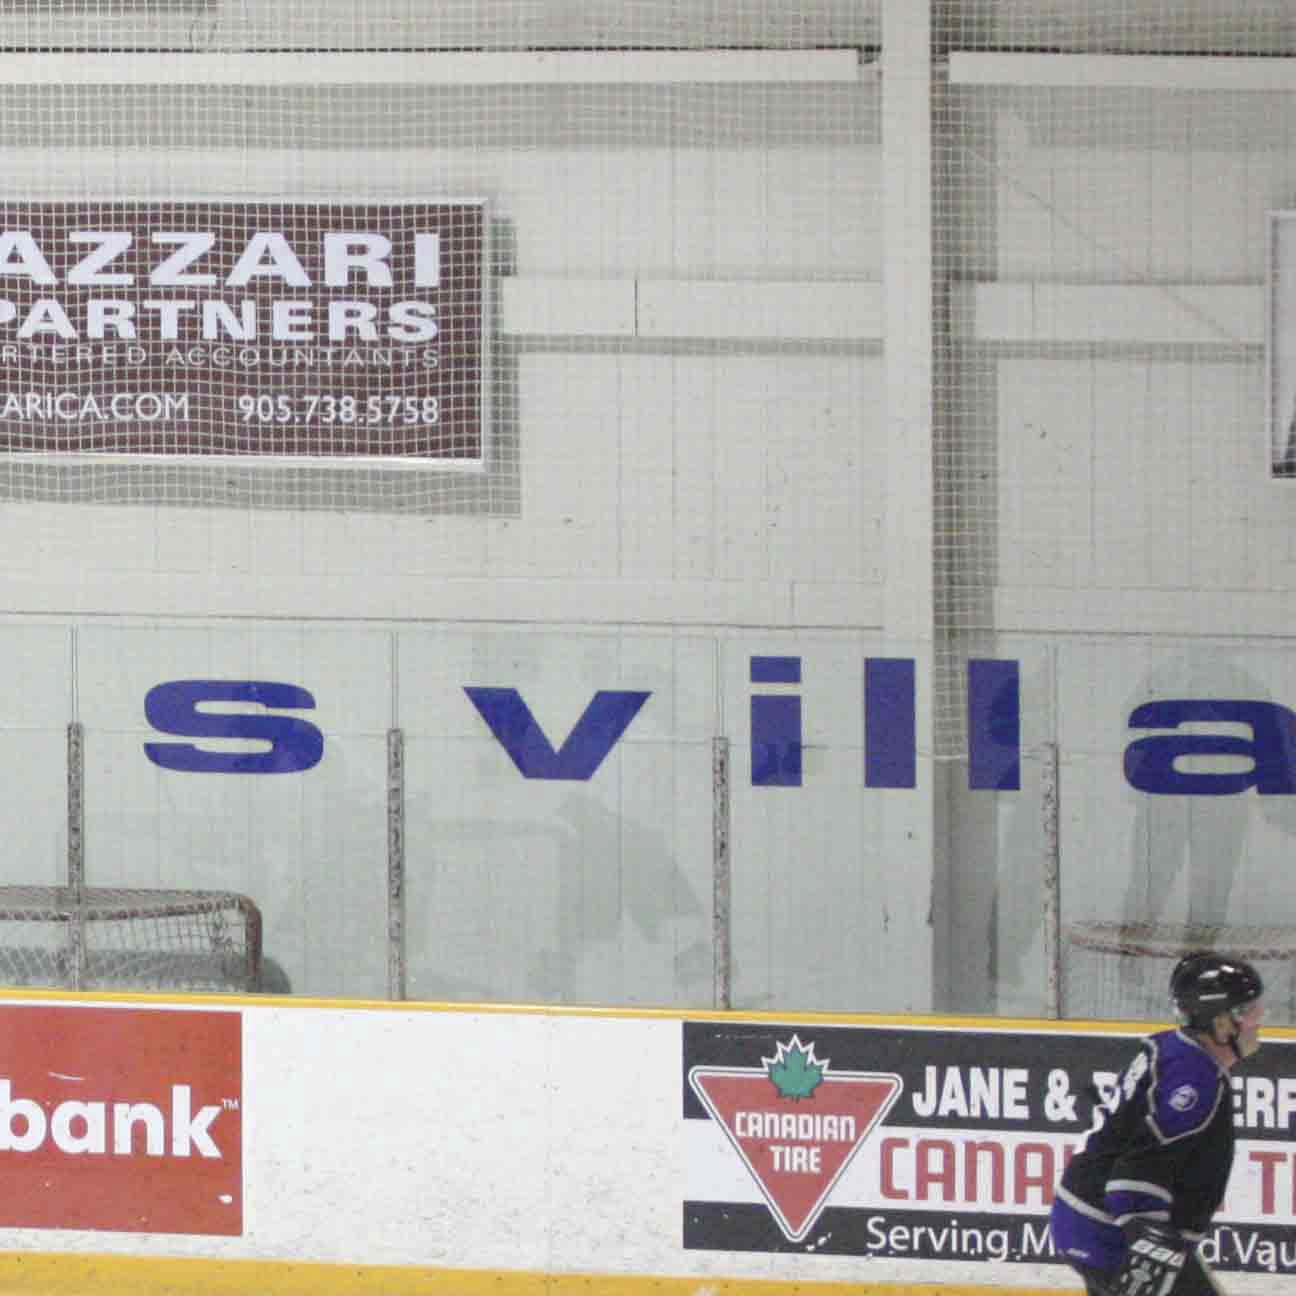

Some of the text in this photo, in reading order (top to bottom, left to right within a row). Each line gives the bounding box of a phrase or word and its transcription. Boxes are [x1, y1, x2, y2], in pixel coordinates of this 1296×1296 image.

[165, 346, 440, 369] ACCOUNTANTS
[238, 394, 440, 425] 905.738.5758
[911, 1065, 1029, 1120] JANE
[1044, 1068, 1078, 1122] &
[735, 1112, 856, 1142] CANADIAN
[769, 1145, 822, 1173] TIRE
[866, 1215, 1008, 1263] Serving
